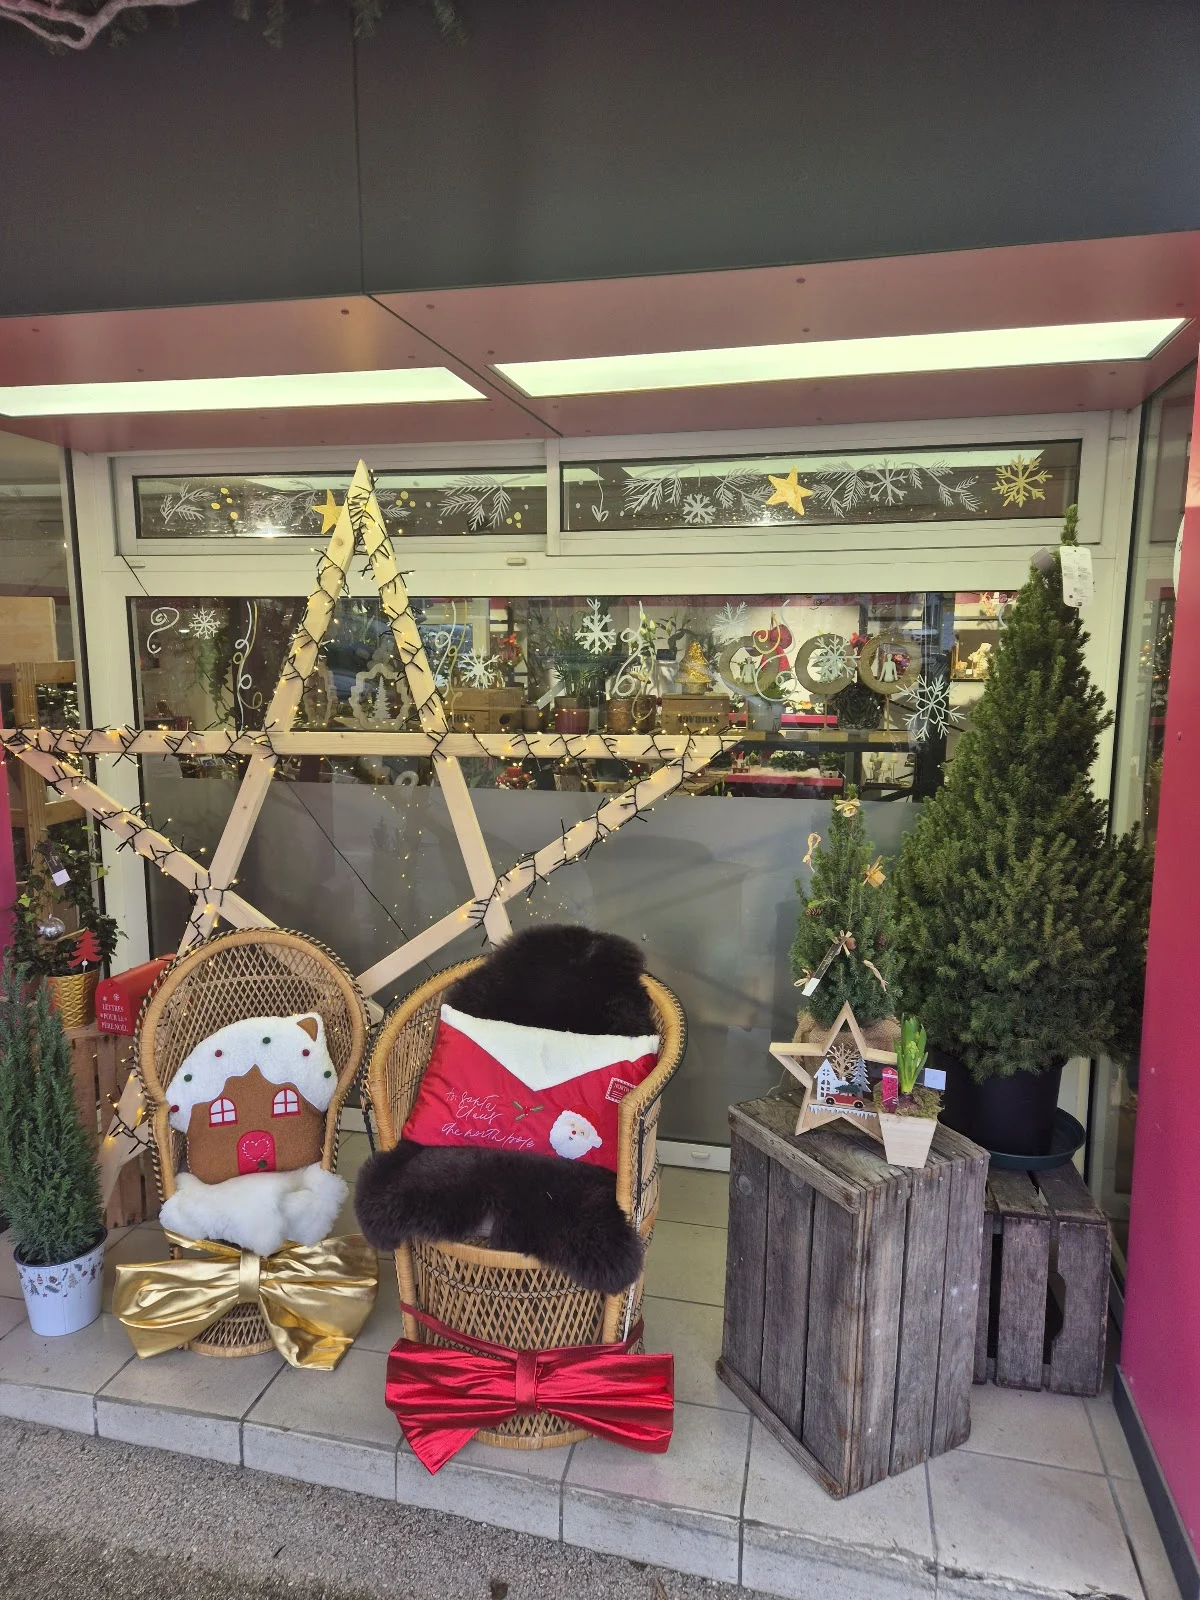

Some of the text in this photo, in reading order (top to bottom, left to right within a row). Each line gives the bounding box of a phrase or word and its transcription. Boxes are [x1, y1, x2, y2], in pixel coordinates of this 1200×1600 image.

[676, 715, 720, 724] STORAGE
[102, 1004, 124, 1012] LETTRES
[103, 1013, 118, 1021] POUR
